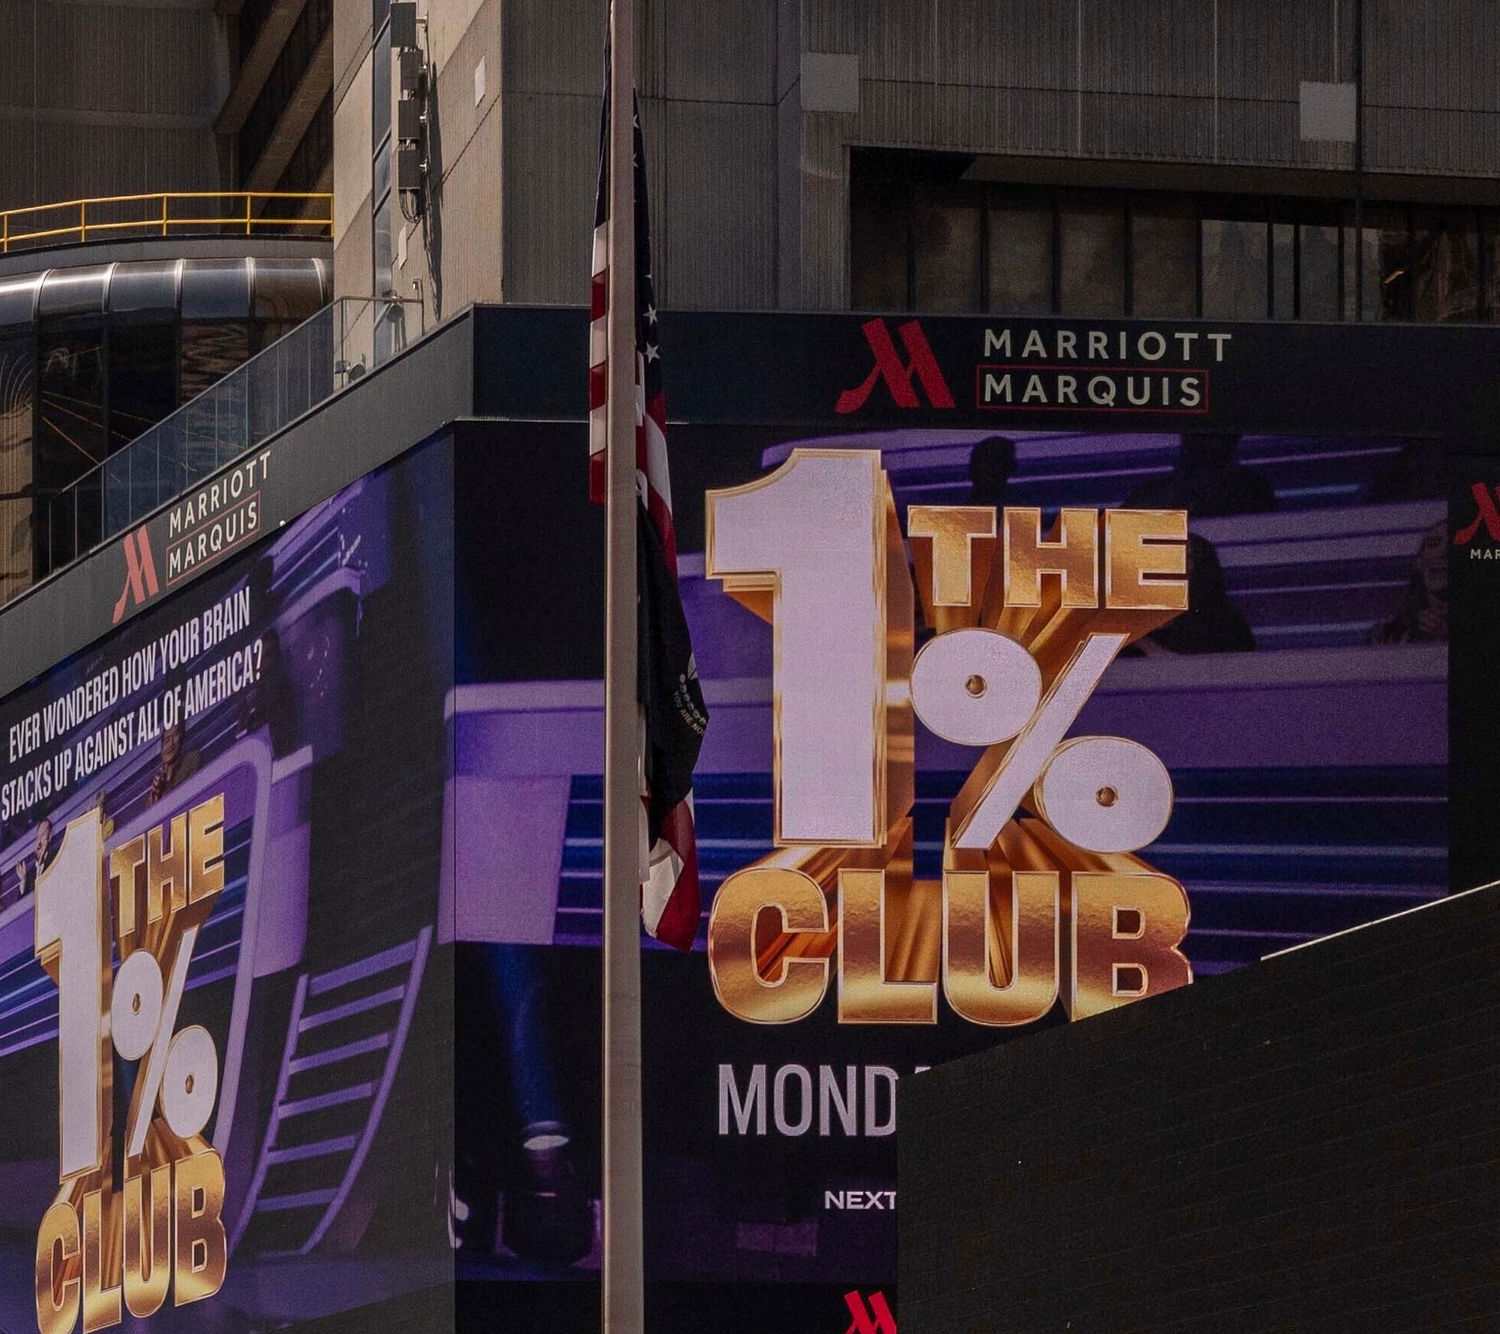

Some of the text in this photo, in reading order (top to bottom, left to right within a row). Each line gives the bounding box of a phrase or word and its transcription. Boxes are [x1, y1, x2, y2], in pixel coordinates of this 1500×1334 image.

[982, 329, 1232, 362] MARRIOTT
[983, 371, 1201, 407] MARQUIS
[168, 502, 259, 580] MARQUIS
[169, 451, 271, 538] MARRIOTT
[908, 506, 1189, 609] THE
[9, 586, 250, 763] EVER WONDERED HOW YOUR BRAIN
[1, 639, 263, 821] STACKS UP AGAINST ALL OF AMERICA?
[110, 793, 225, 935] THE
[708, 868, 1193, 1025] CLUB
